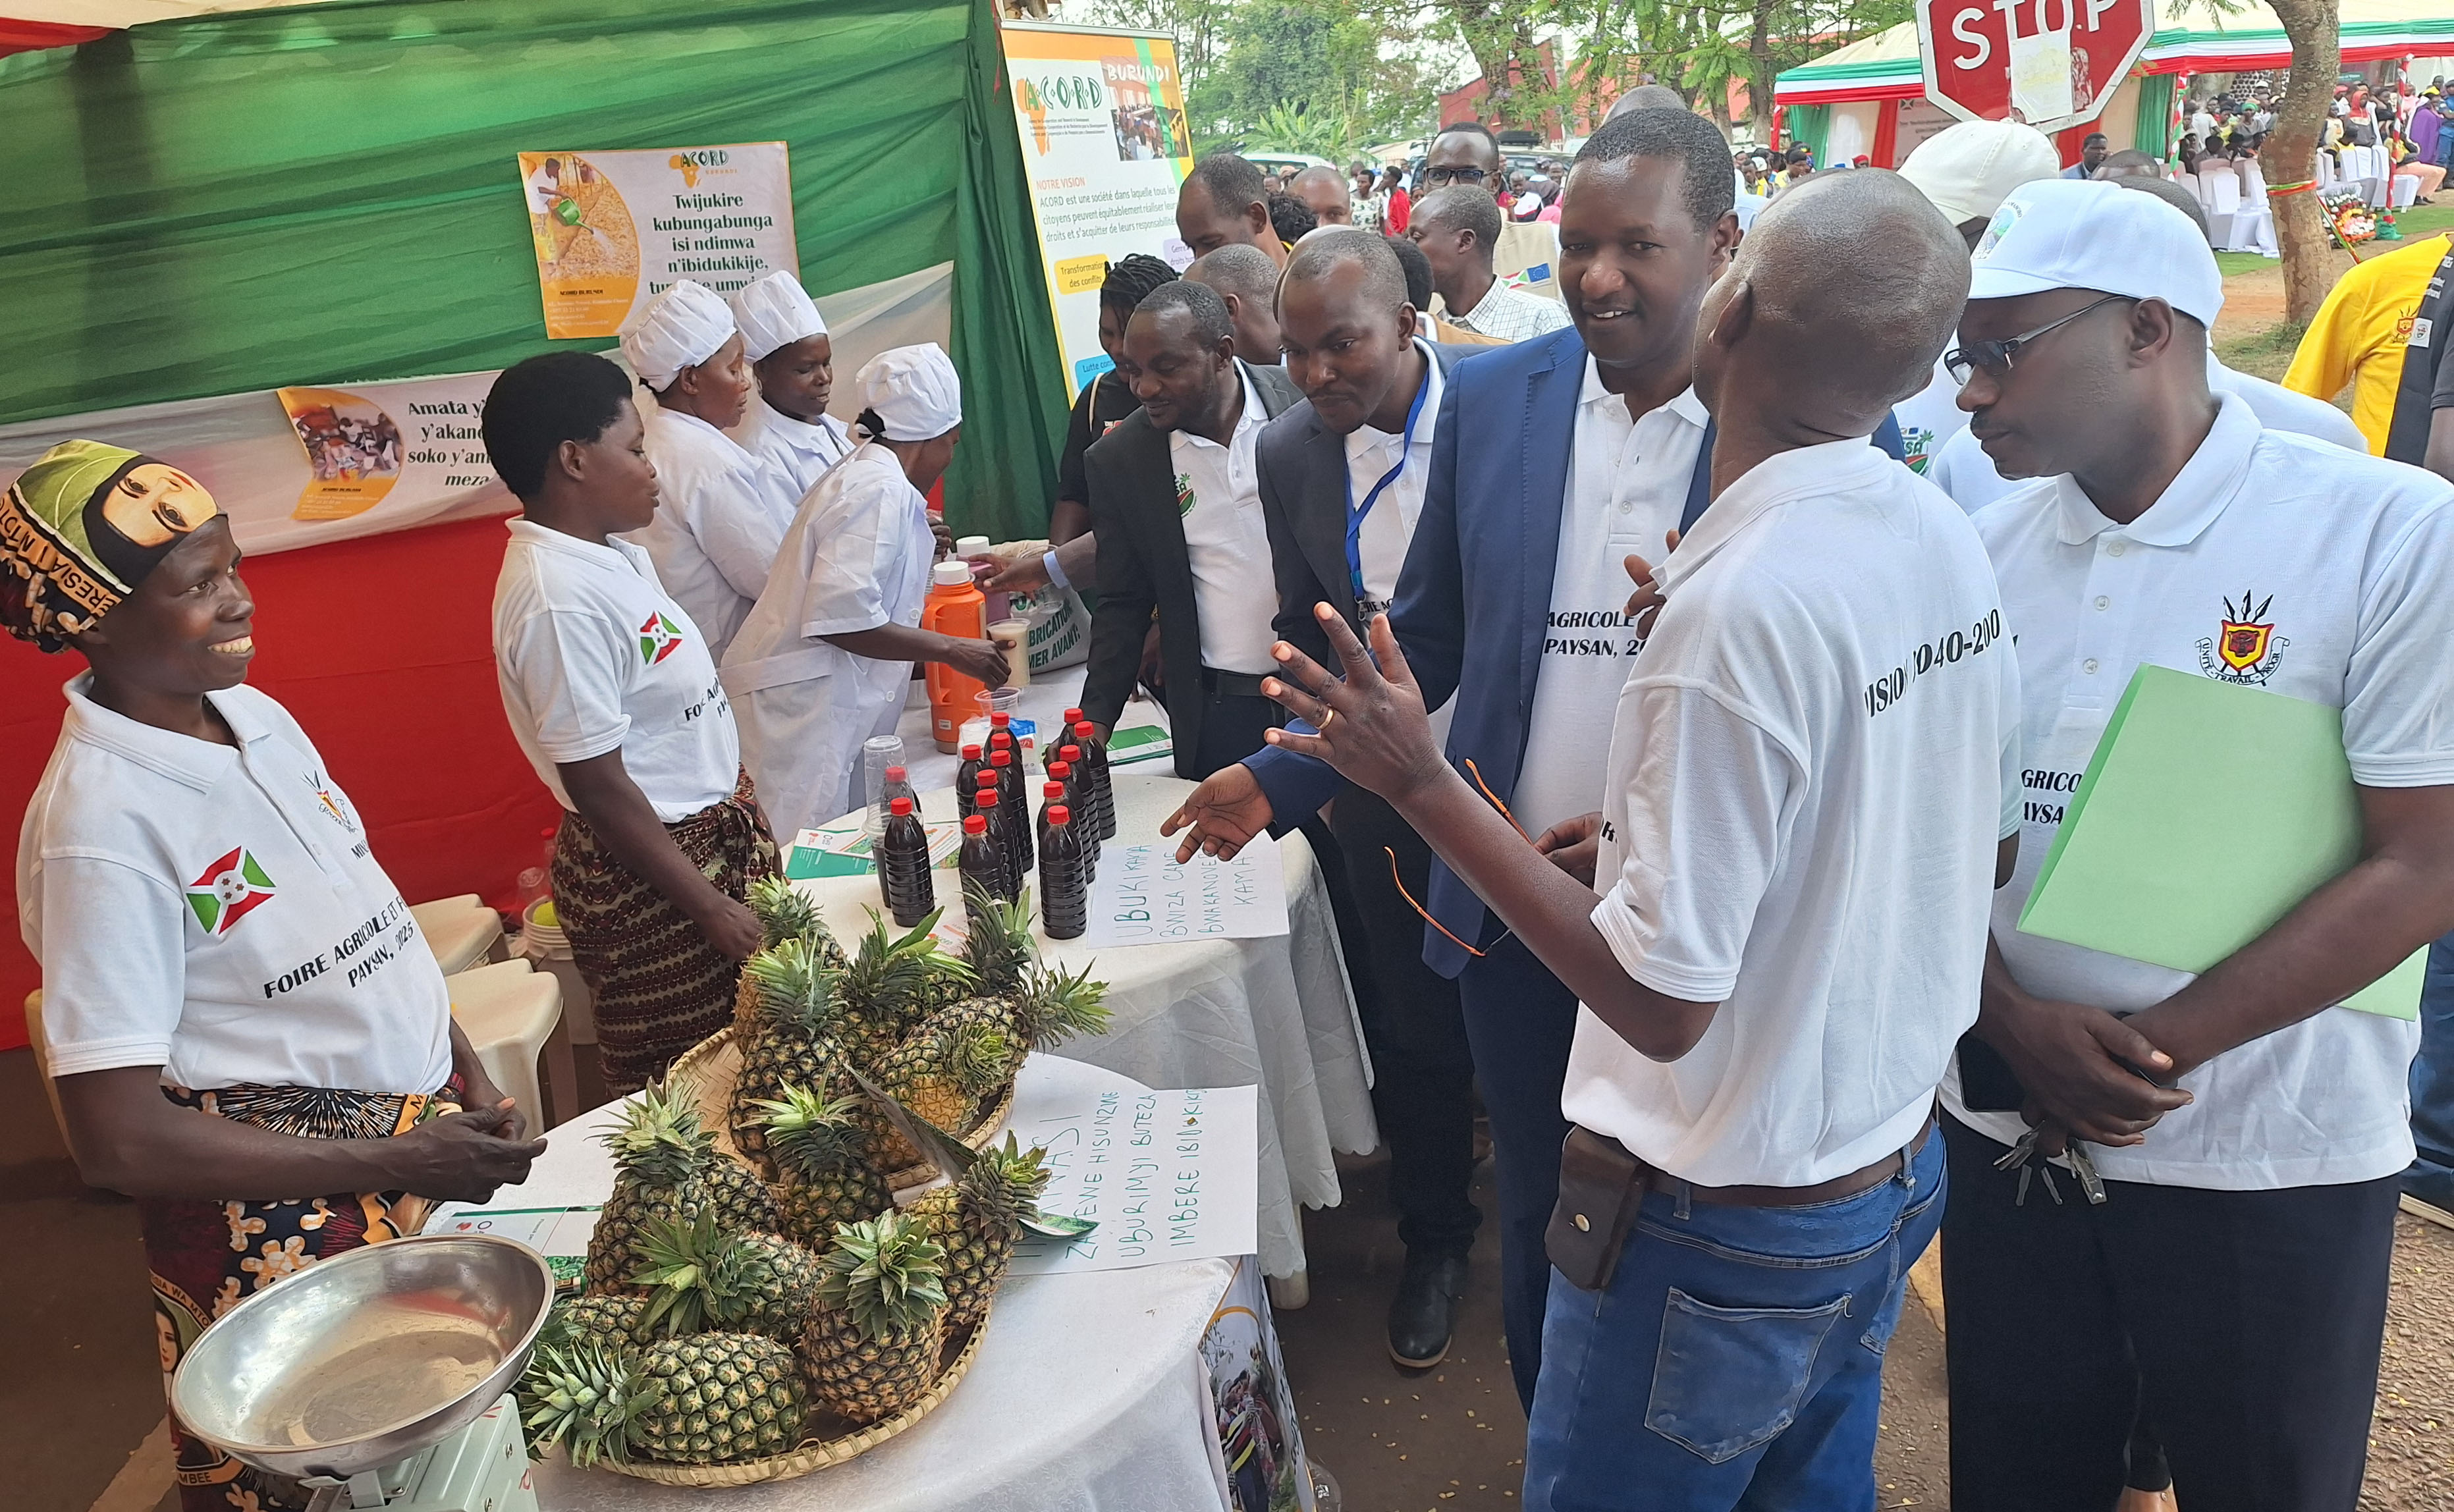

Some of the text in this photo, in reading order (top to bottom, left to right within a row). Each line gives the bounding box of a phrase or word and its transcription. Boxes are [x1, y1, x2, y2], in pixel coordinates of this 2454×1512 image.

[1951, 0, 2117, 70] STOP
[1106, 63, 1170, 82] BURUNDI
[680, 149, 729, 167] ACORD
[1036, 176, 1085, 190] NOTRE VISION
[672, 193, 744, 212] Twijukire
[1041, 184, 1176, 208] ACORD est une société dans laquelle tous les
[1043, 213, 1072, 227] citoyens
[1072, 209, 1099, 225] peuvent
[1164, 200, 1178, 210] leur
[653, 215, 773, 233] kubungabunga
[1046, 230, 1066, 242] droits
[1067, 229, 1076, 239] et
[1109, 224, 1118, 234] de
[1118, 223, 1135, 232] leurs
[1136, 216, 1176, 231] responsabilité
[672, 235, 755, 252] isi ndimwa
[1069, 275, 1103, 288] des conflits
[1082, 362, 1099, 373] Lutte
[408, 400, 469, 416] Amata
[407, 448, 447, 464] soko
[50, 557, 117, 613] ERESIA
[1027, 596, 1074, 648] BRICATION
[1546, 611, 1635, 628] AGRICOLE
[1543, 639, 1618, 659] PAYSAN,
[2214, 672, 2255, 685] TRAVAIL
[2021, 769, 2083, 793] GRICO
[1114, 875, 1153, 938] UBUKI
[263, 954, 331, 999] FOIRE
[334, 909, 391, 965] AGRICOLE
[387, 900, 399, 921] ET
[347, 921, 414, 988] PAYSAN, 2025
[1168, 1170, 1201, 1247] IMBERE
[172, 1286, 187, 1304] WA
[190, 1303, 209, 1327] MTO
[179, 1472, 212, 1484] MBEE
